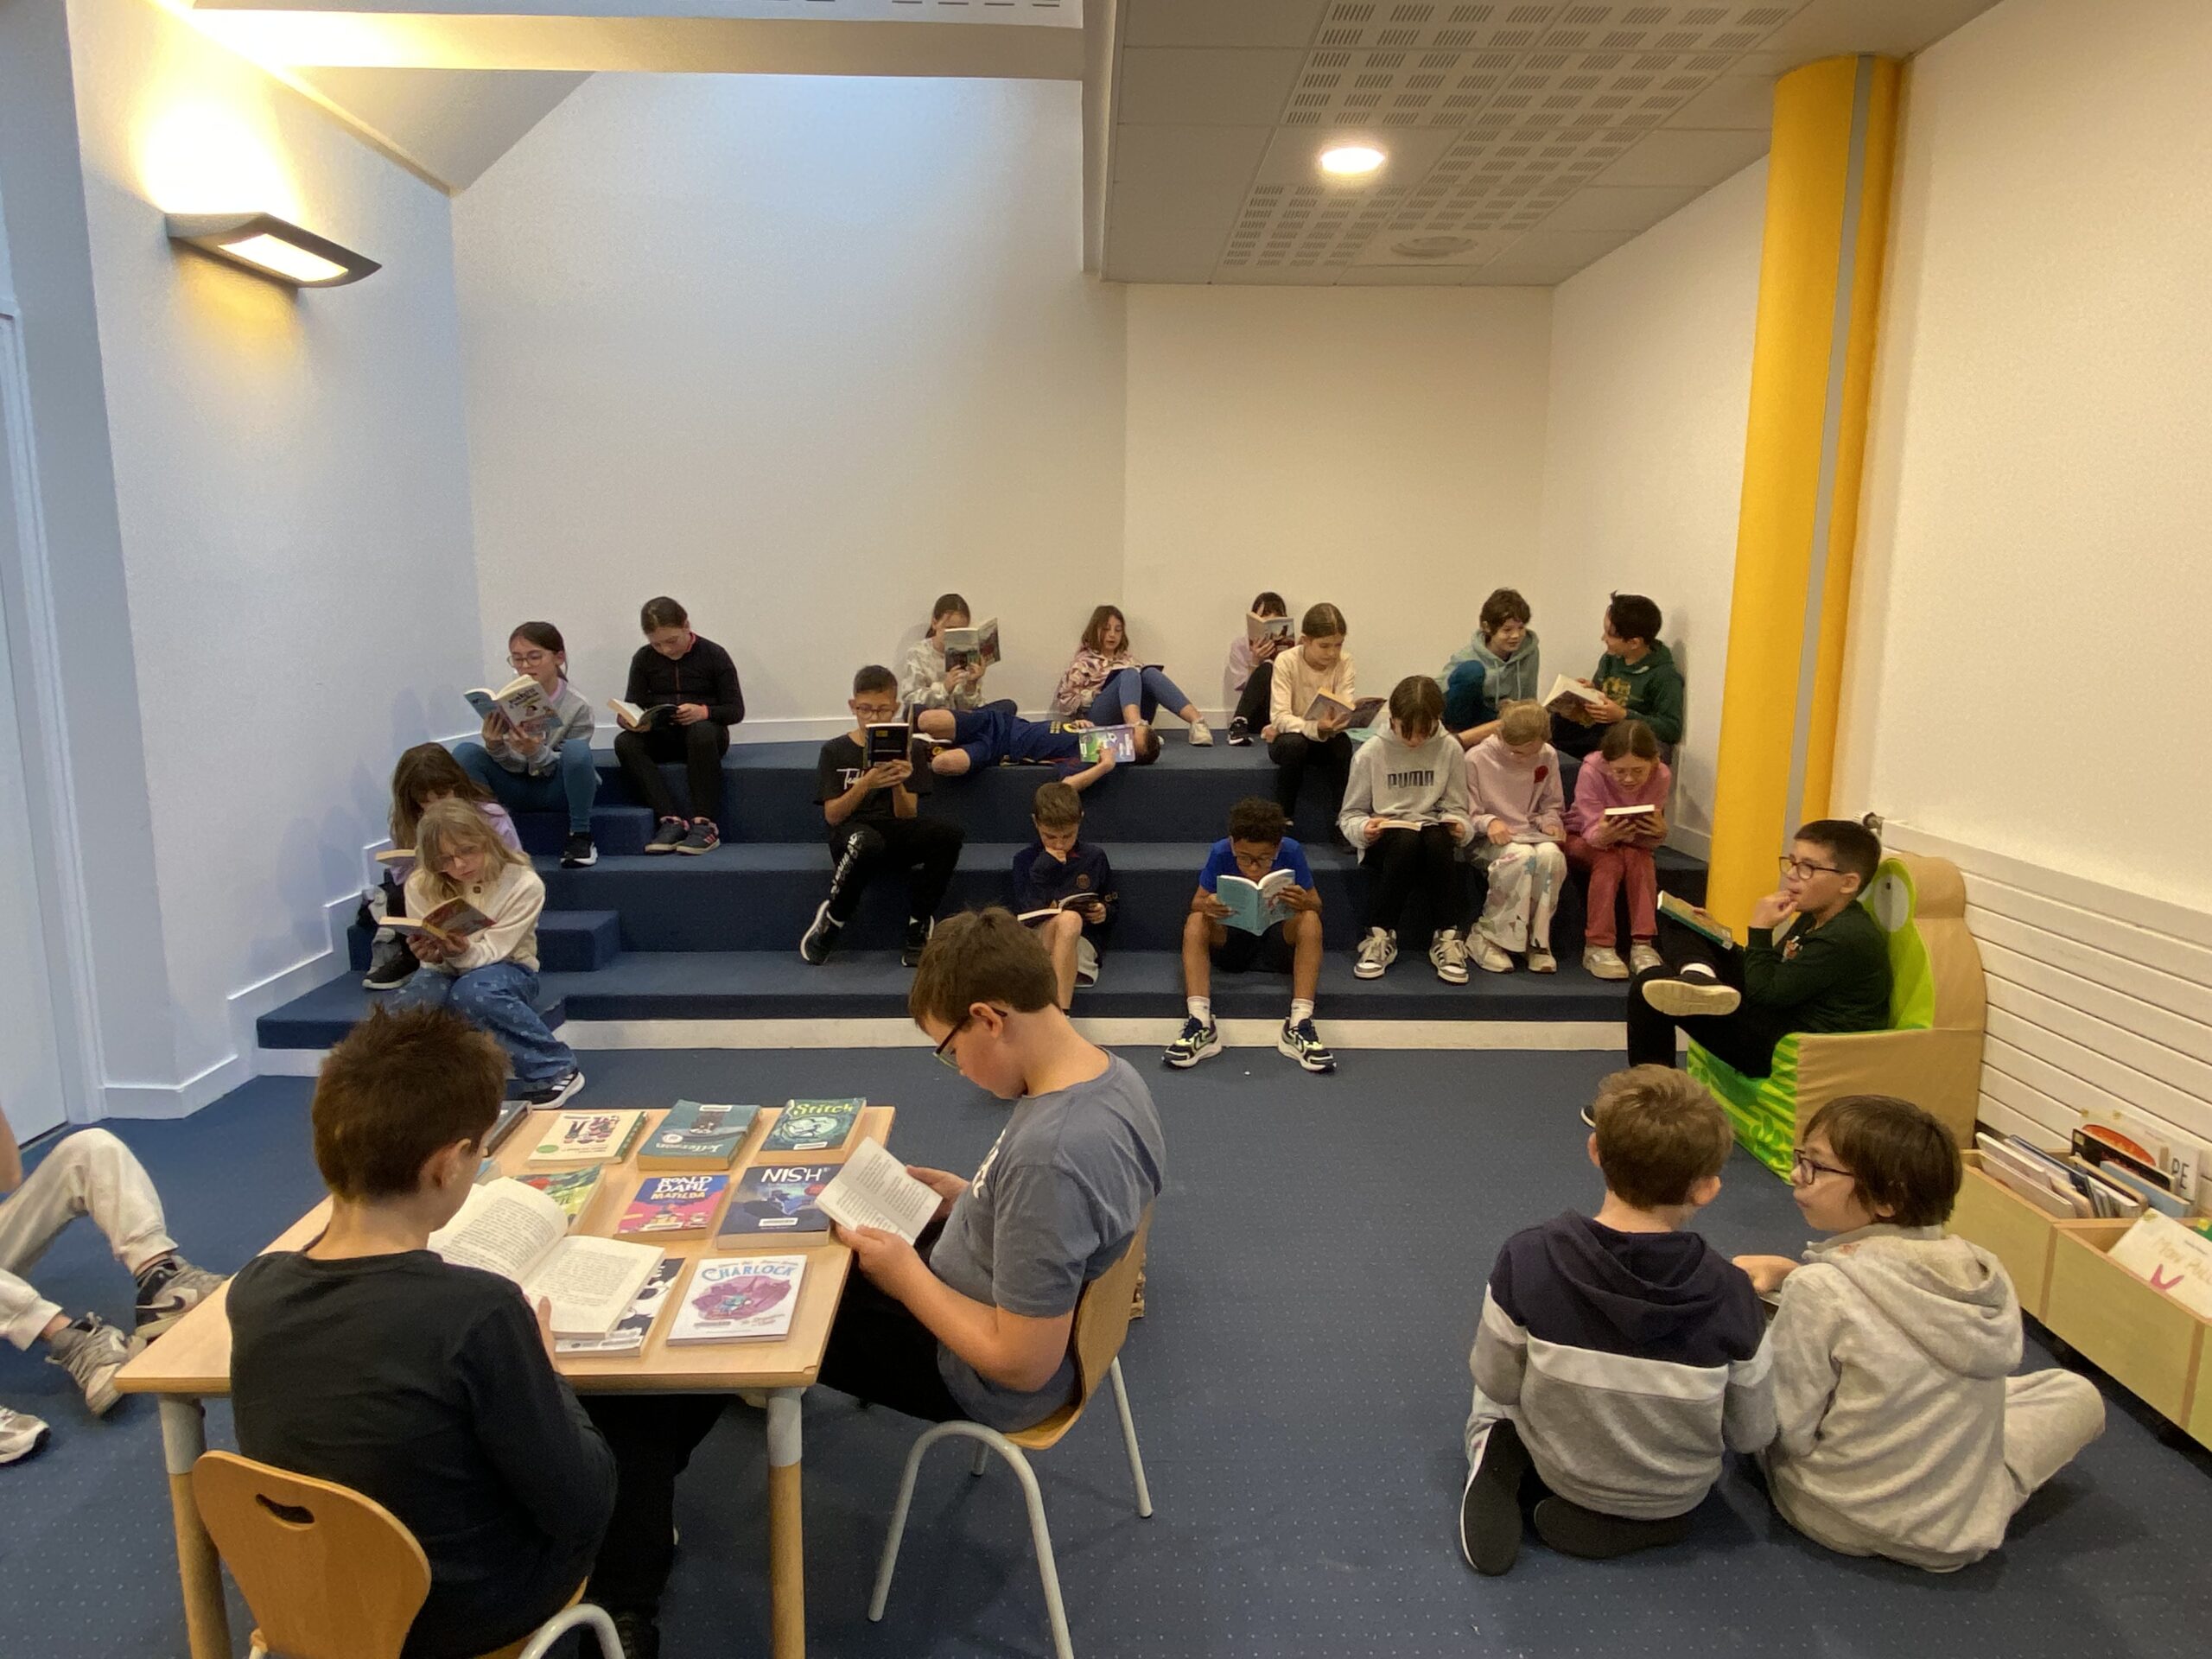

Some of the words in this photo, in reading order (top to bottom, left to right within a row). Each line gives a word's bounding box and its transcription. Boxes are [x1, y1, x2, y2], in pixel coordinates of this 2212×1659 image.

[1388, 771, 1433, 790] PUMA
[793, 1103, 853, 1115] Stitch
[655, 1142, 723, 1153] Jefferson
[760, 1166, 822, 1183] NISH
[660, 1176, 713, 1185] ROALD
[655, 1182, 709, 1193] DAHL
[651, 1192, 706, 1200] MATILDA
[701, 1264, 798, 1282] CHARLOCK
